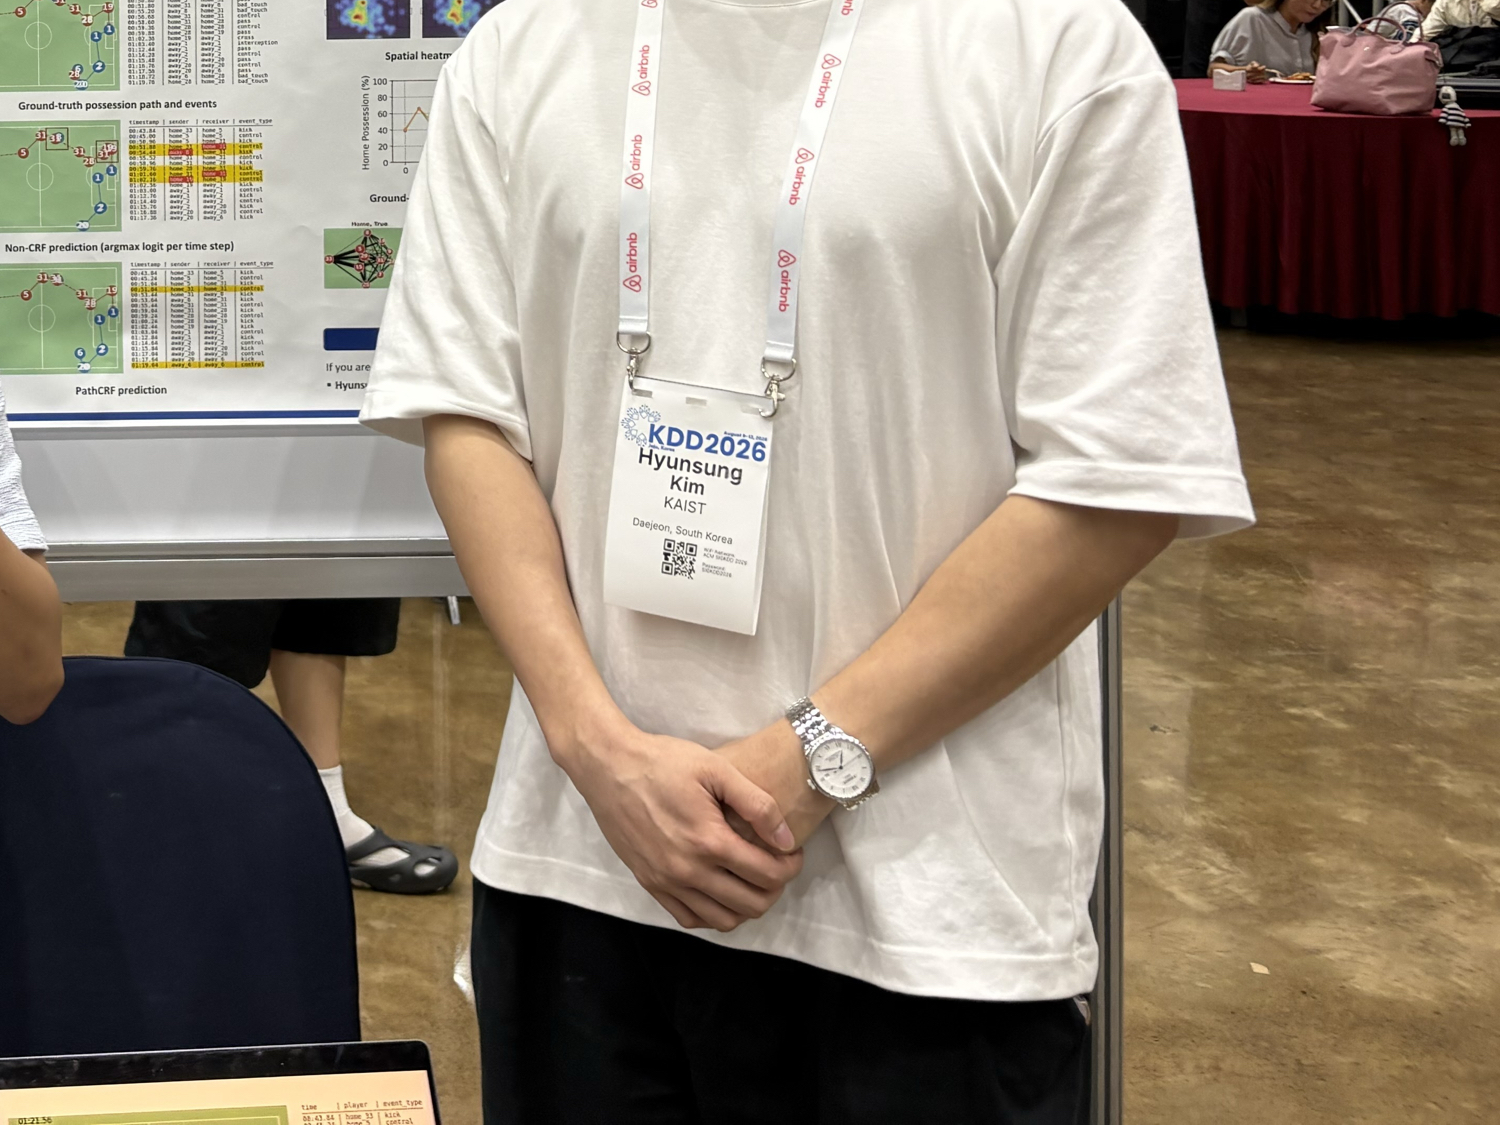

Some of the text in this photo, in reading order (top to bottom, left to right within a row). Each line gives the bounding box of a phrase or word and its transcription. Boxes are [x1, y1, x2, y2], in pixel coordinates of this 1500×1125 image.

[640, 45, 650, 78] airbnb
[815, 71, 832, 108] airbnb
[632, 134, 643, 171] airbnb
[789, 167, 805, 205] airbnb
[628, 233, 637, 272] airbnb
[779, 271, 789, 312] airbnb
[75, 385, 167, 396] PathCRF prediction
[648, 423, 766, 462] KDD2026
[638, 447, 743, 485] Hyunsung
[670, 475, 705, 495] Kim
[664, 496, 706, 515] KAIST
[632, 517, 733, 545] Daejeon, South Korea
[383, 1100, 422, 1108] event_type
